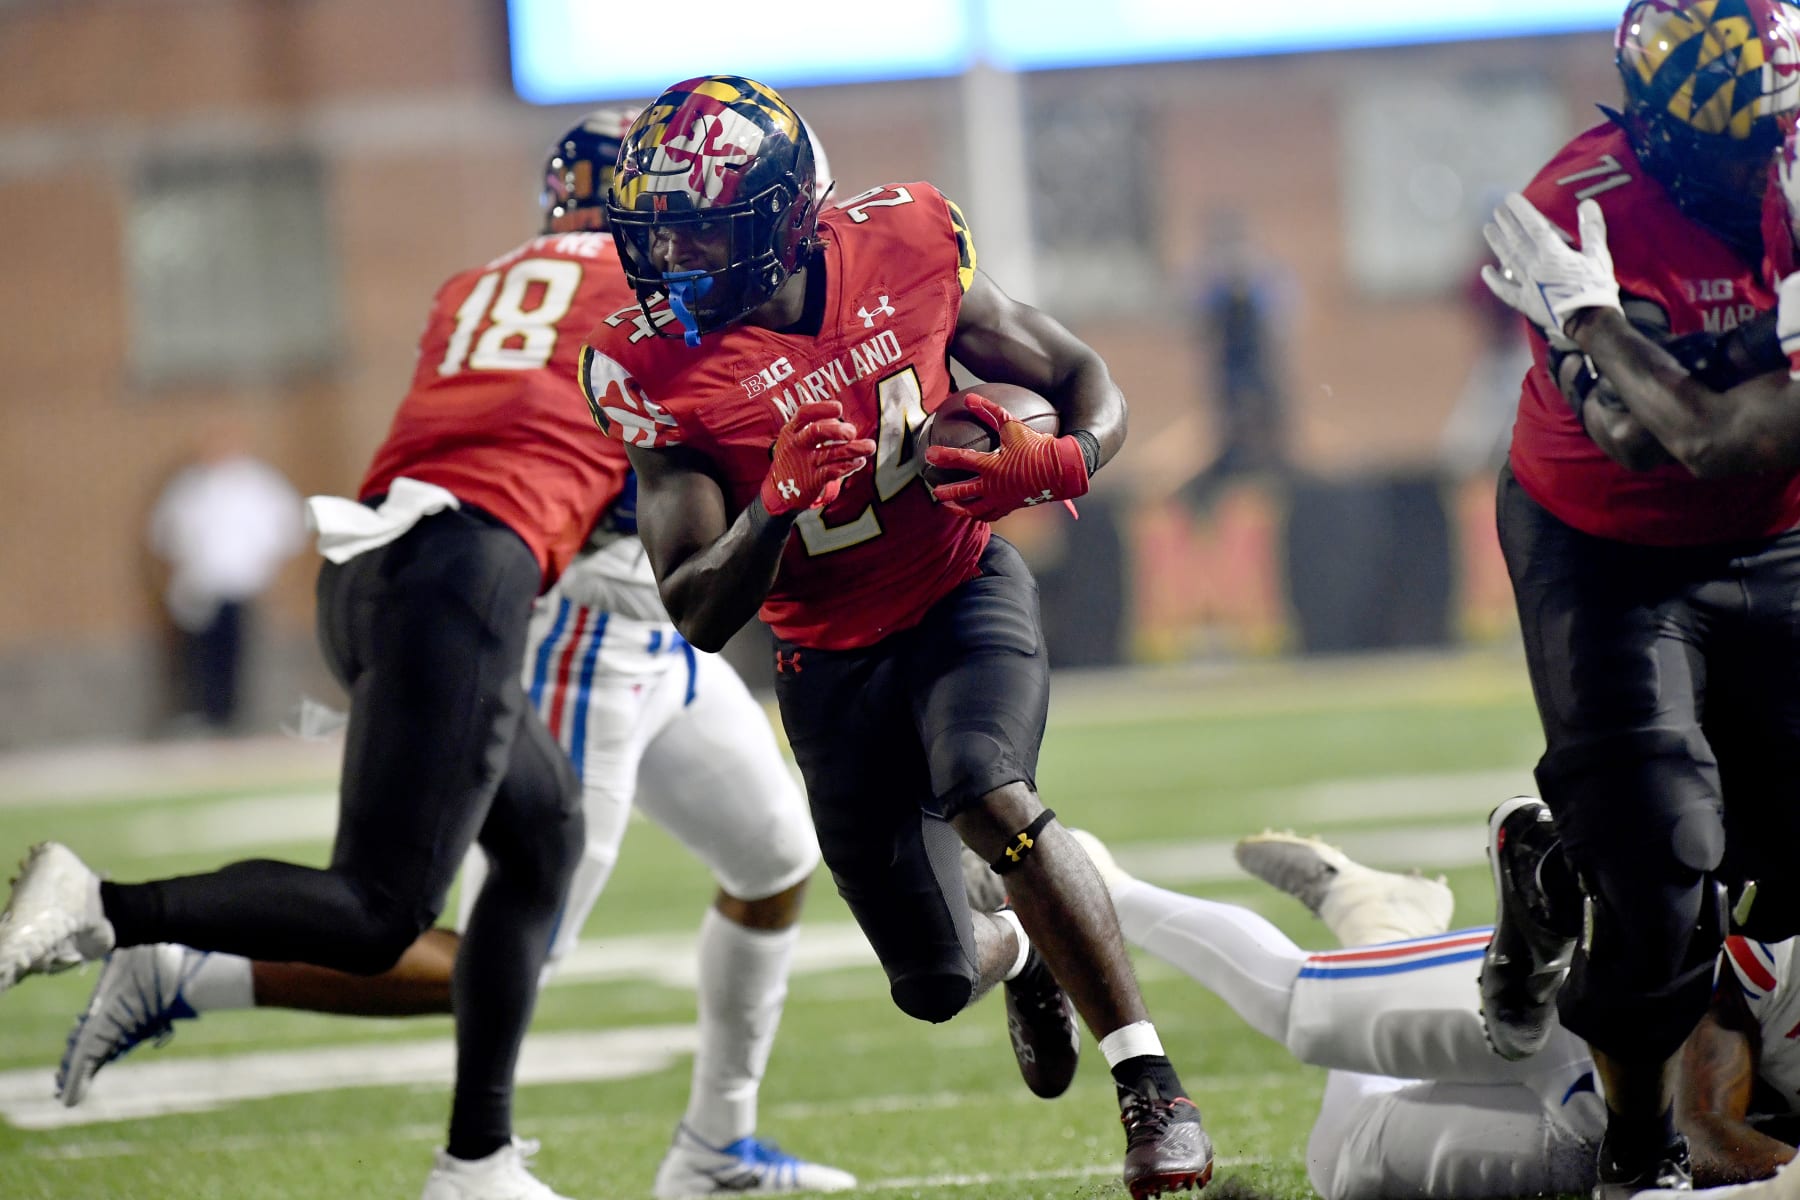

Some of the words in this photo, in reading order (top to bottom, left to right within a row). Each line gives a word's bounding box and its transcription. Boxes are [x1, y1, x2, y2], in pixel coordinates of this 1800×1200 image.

[653, 195, 668, 212] M
[437, 258, 583, 376] 18
[603, 290, 677, 344] 24
[771, 329, 903, 424] MARYLAND
